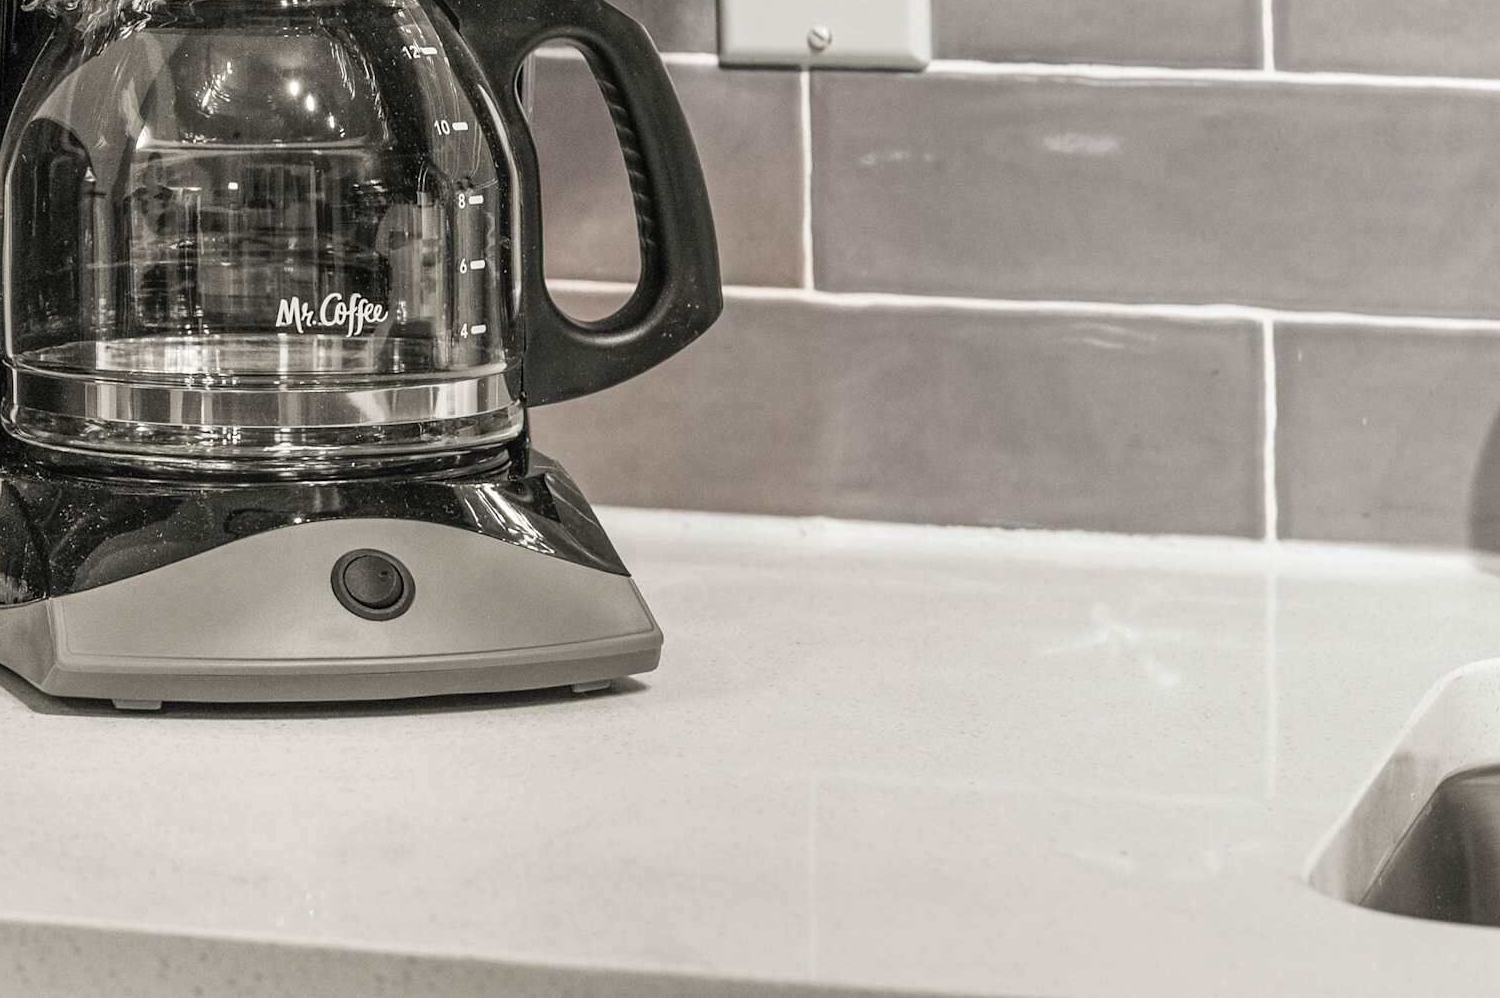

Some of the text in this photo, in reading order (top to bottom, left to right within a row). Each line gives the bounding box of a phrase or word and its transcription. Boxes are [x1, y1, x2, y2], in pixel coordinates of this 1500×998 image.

[433, 119, 451, 136] 10
[458, 192, 466, 209] 8
[459, 258, 468, 274] 6
[275, 293, 388, 338] Mr. Coffee
[460, 323, 469, 339] 4
